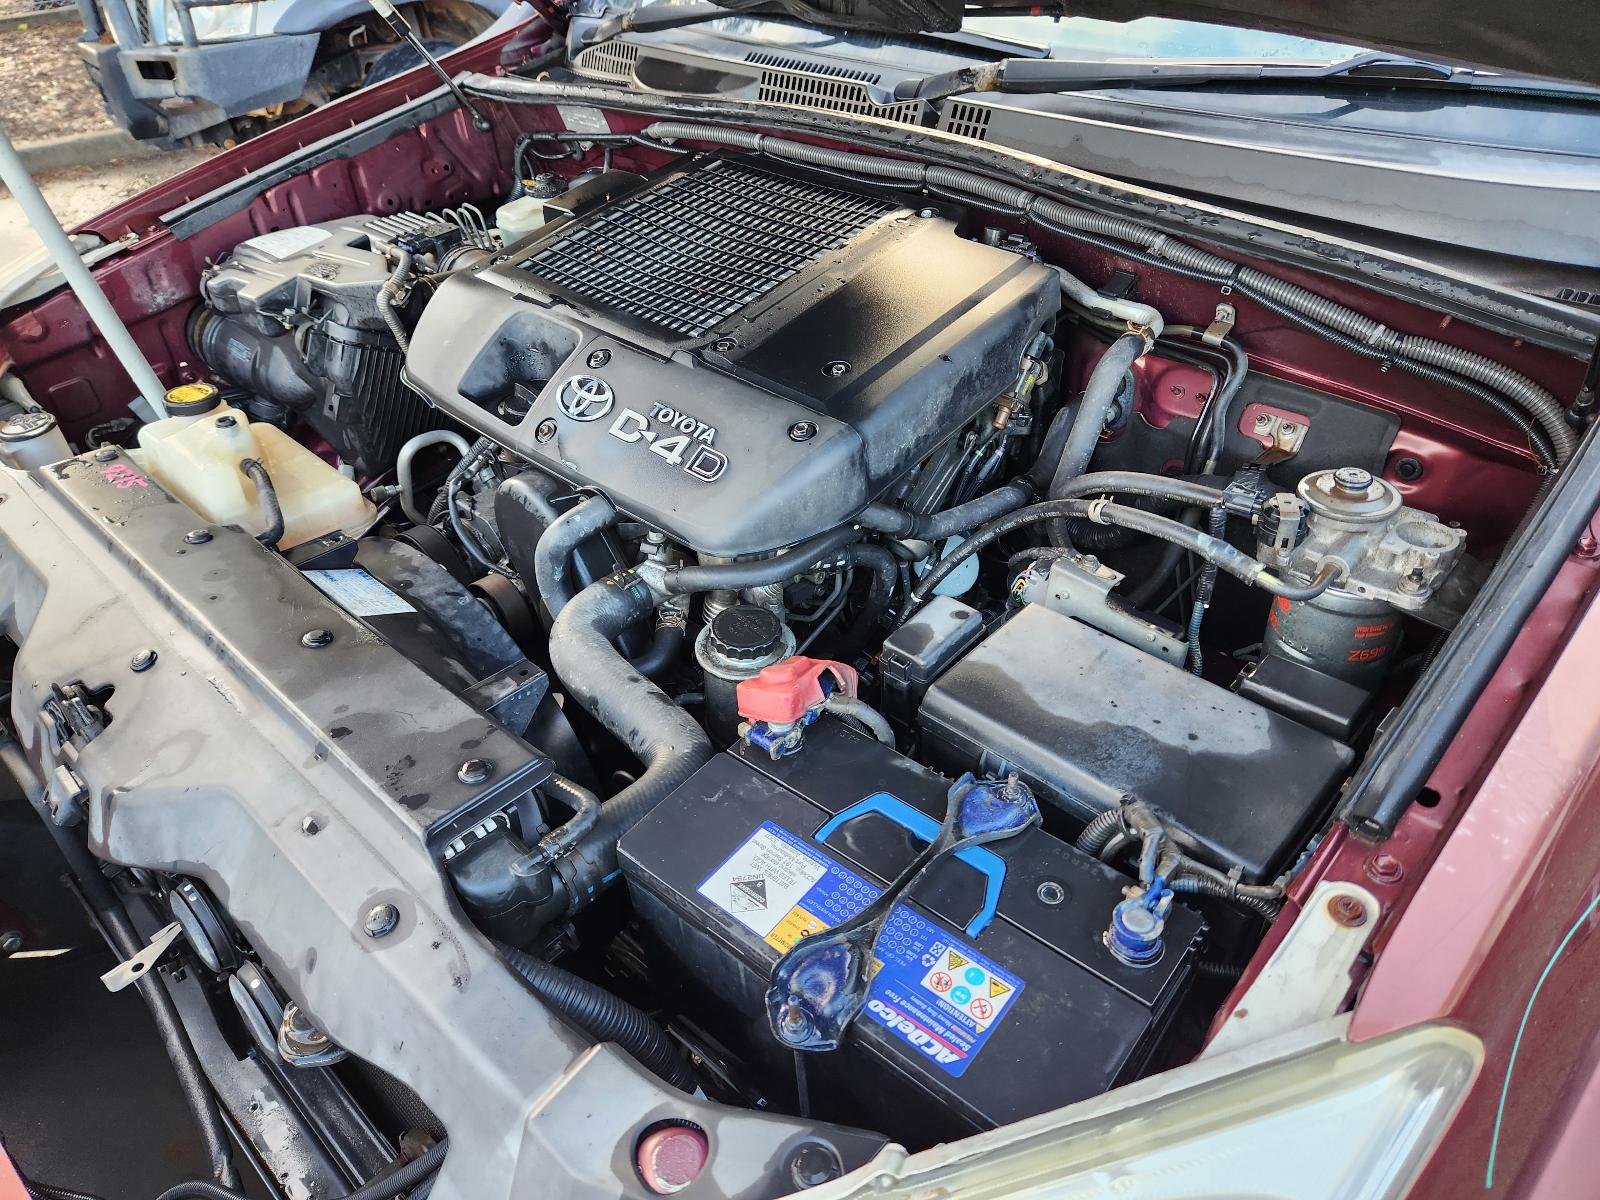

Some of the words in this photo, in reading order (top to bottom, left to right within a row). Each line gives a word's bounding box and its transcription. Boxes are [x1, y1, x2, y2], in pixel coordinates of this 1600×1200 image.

[649, 400, 717, 446] TOYOTA
[732, 873, 764, 881] UN2794
[764, 862, 780, 874] WITH
[778, 871, 797, 885] FILLED
[737, 881, 766, 903] CORROSIVE
[883, 988, 902, 1003] Free
[898, 998, 946, 1034] Maintenance
[934, 997, 976, 1028] ATTENTION!
[866, 997, 961, 1064] ACDelco
[941, 1029, 972, 1051] Sealed
